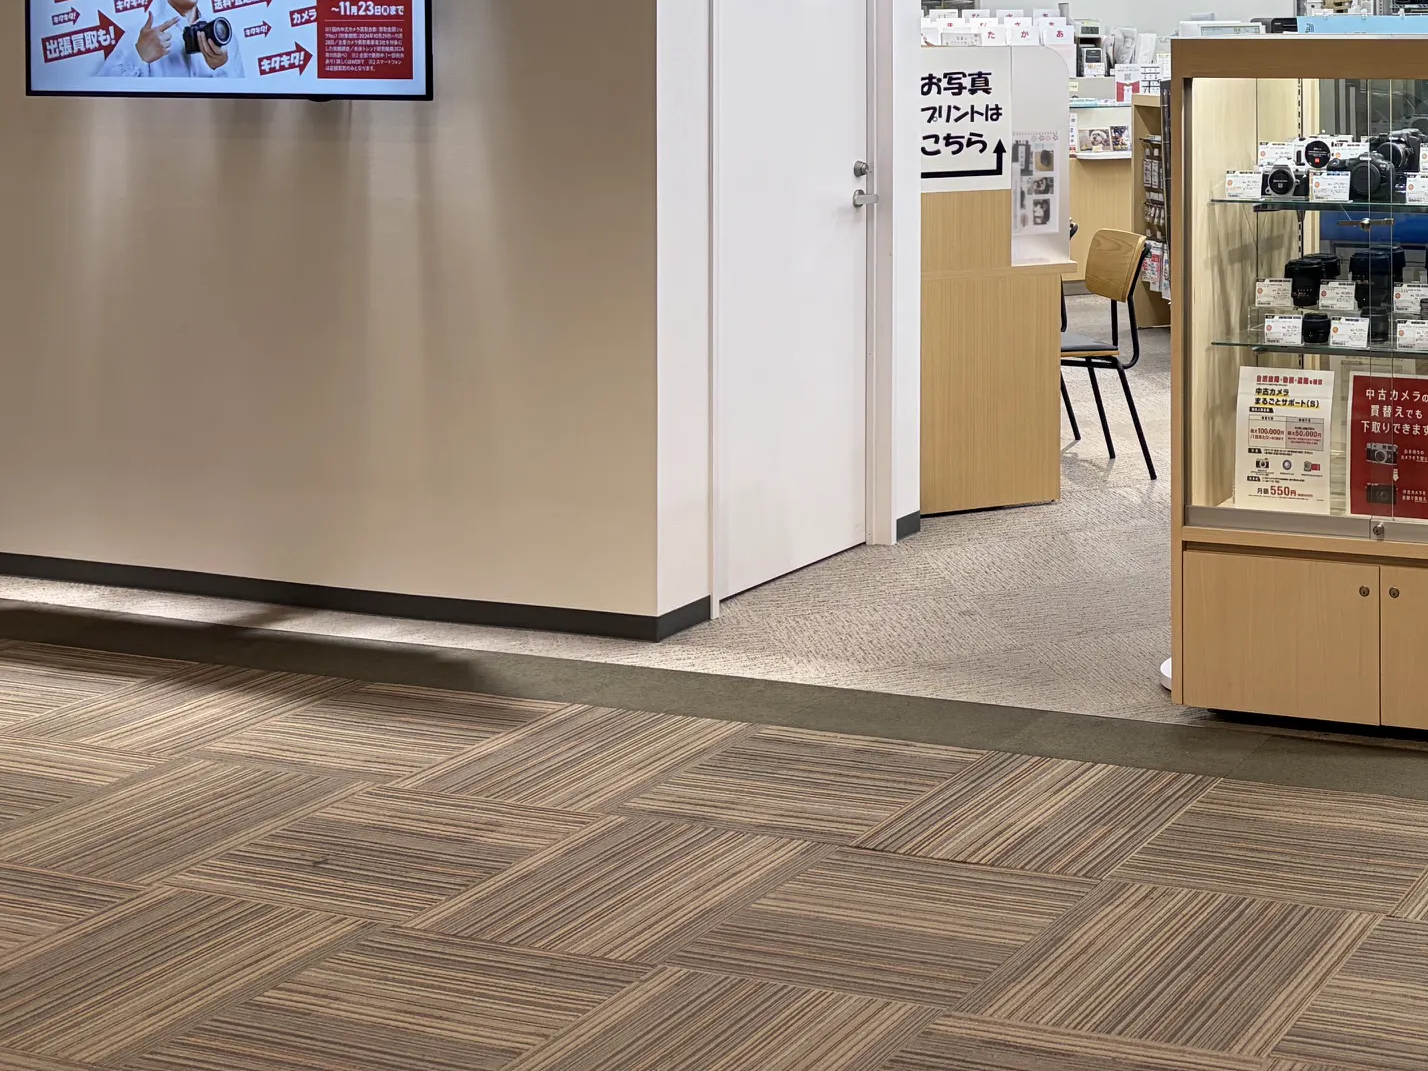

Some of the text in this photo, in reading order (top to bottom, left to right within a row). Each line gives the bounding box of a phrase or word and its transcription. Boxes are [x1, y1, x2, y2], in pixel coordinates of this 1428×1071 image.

[292, 8, 317, 24] カメラ
[45, 25, 117, 59] 出張買取も!
[987, 30, 996, 39] た
[1020, 30, 1029, 39] か
[1056, 30, 1064, 38] あ
[260, 51, 306, 72] キタキタ!
[921, 71, 993, 97] お写真
[921, 103, 1003, 124] プリントは
[921, 131, 988, 157] こちら
[1255, 388, 1290, 396] 中古カメラ
[1370, 404, 1423, 419] 買替えでも
